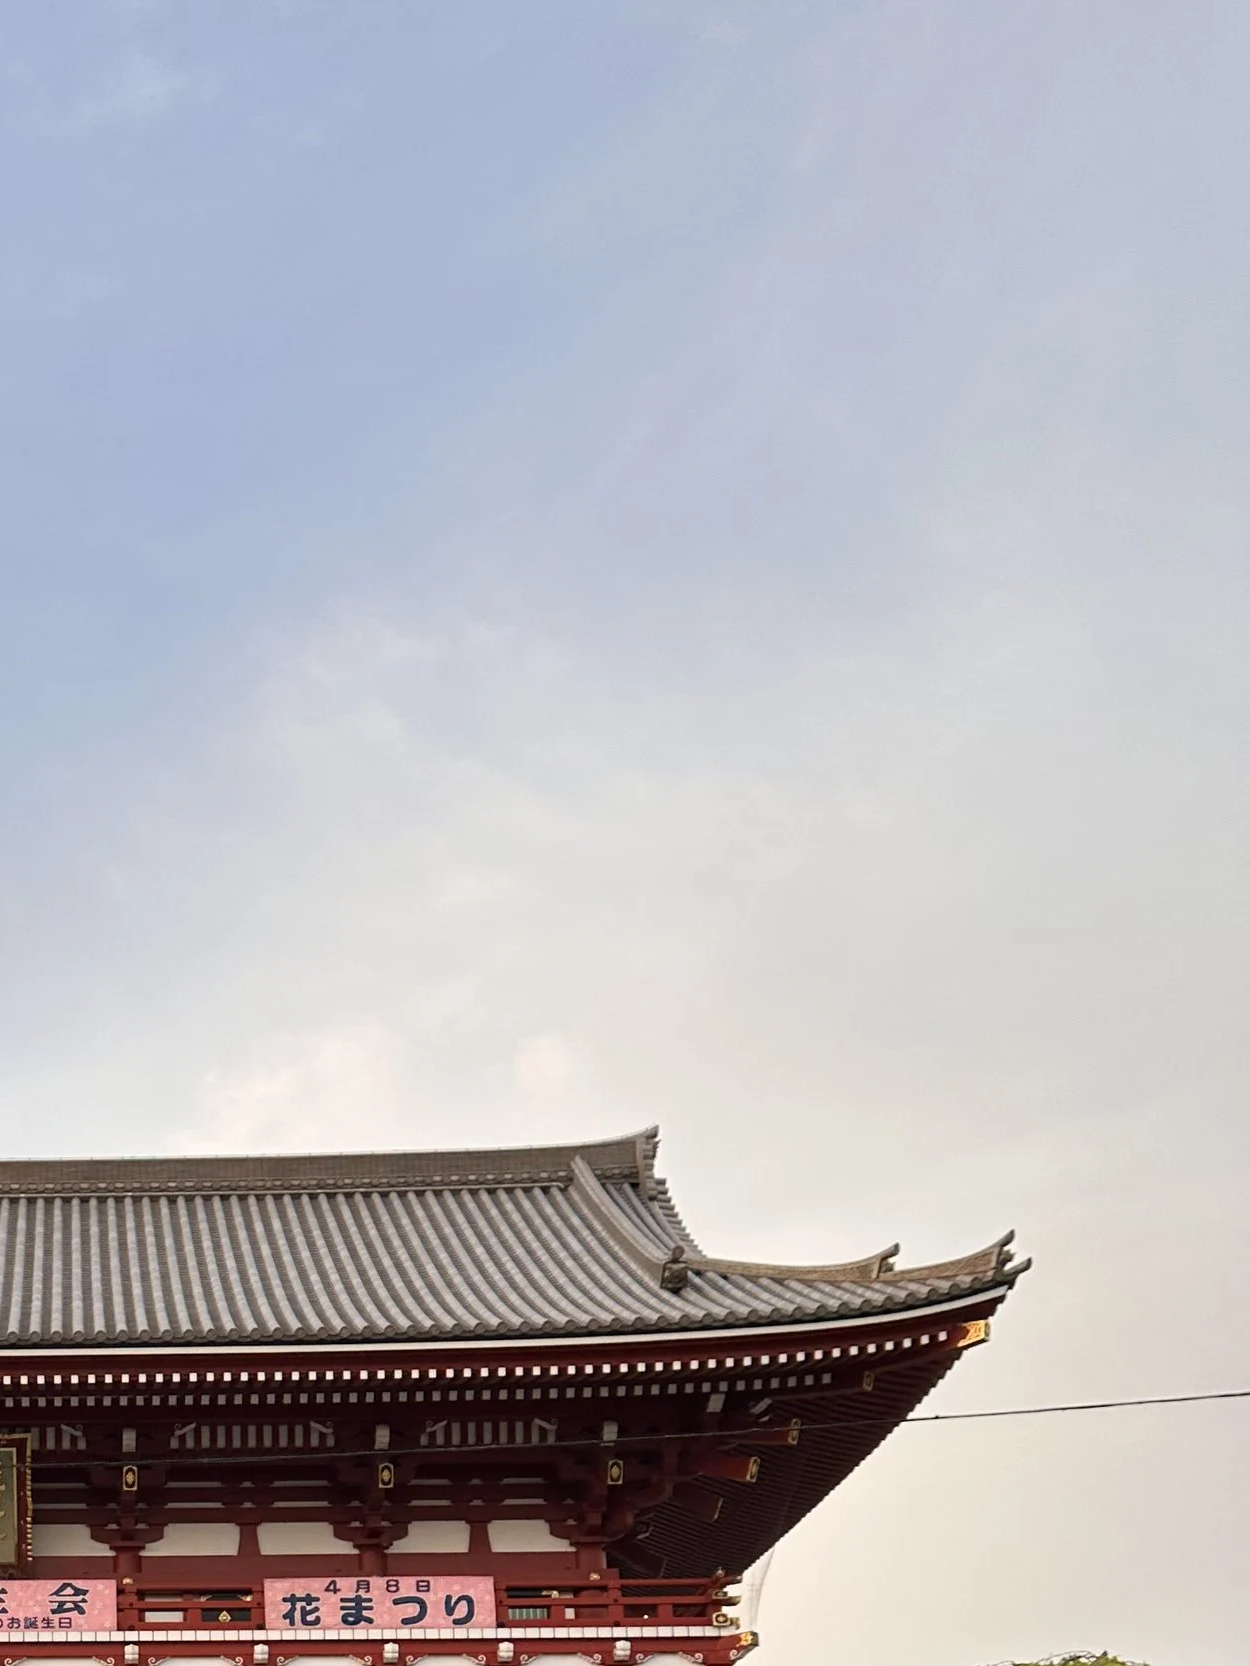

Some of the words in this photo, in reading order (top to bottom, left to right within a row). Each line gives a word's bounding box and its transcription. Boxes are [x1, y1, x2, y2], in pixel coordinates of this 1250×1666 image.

[324, 1579, 431, 1593] 4月8日
[281, 1593, 476, 1627] 花まつり
